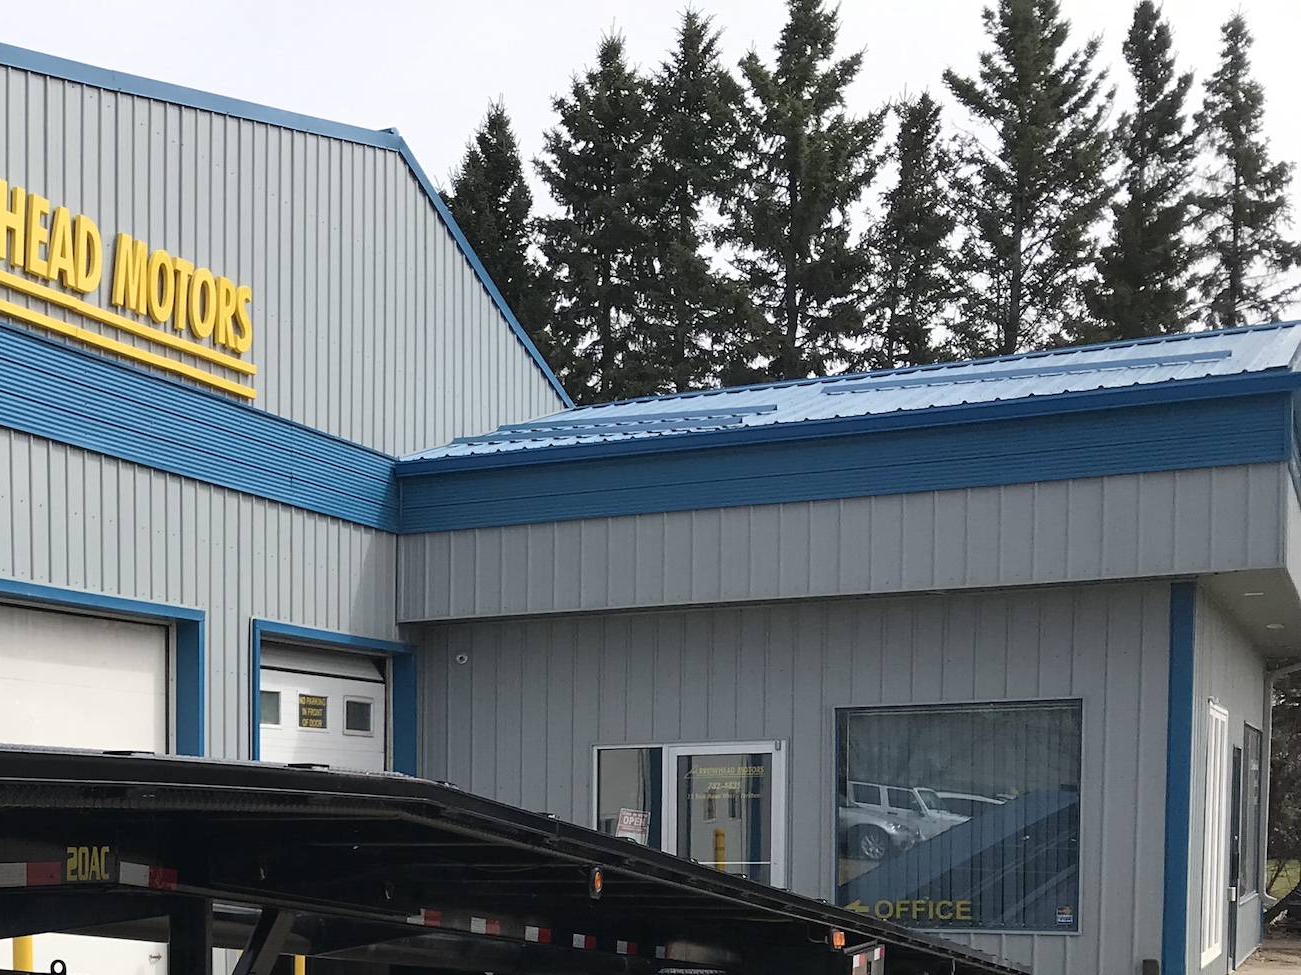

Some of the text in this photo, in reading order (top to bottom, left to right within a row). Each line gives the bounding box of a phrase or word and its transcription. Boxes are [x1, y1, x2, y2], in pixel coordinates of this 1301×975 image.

[112, 231, 253, 354] MOTORS
[623, 815, 646, 827] OPEN
[66, 846, 110, 881] 20AC
[874, 900, 973, 920] OFFICE
